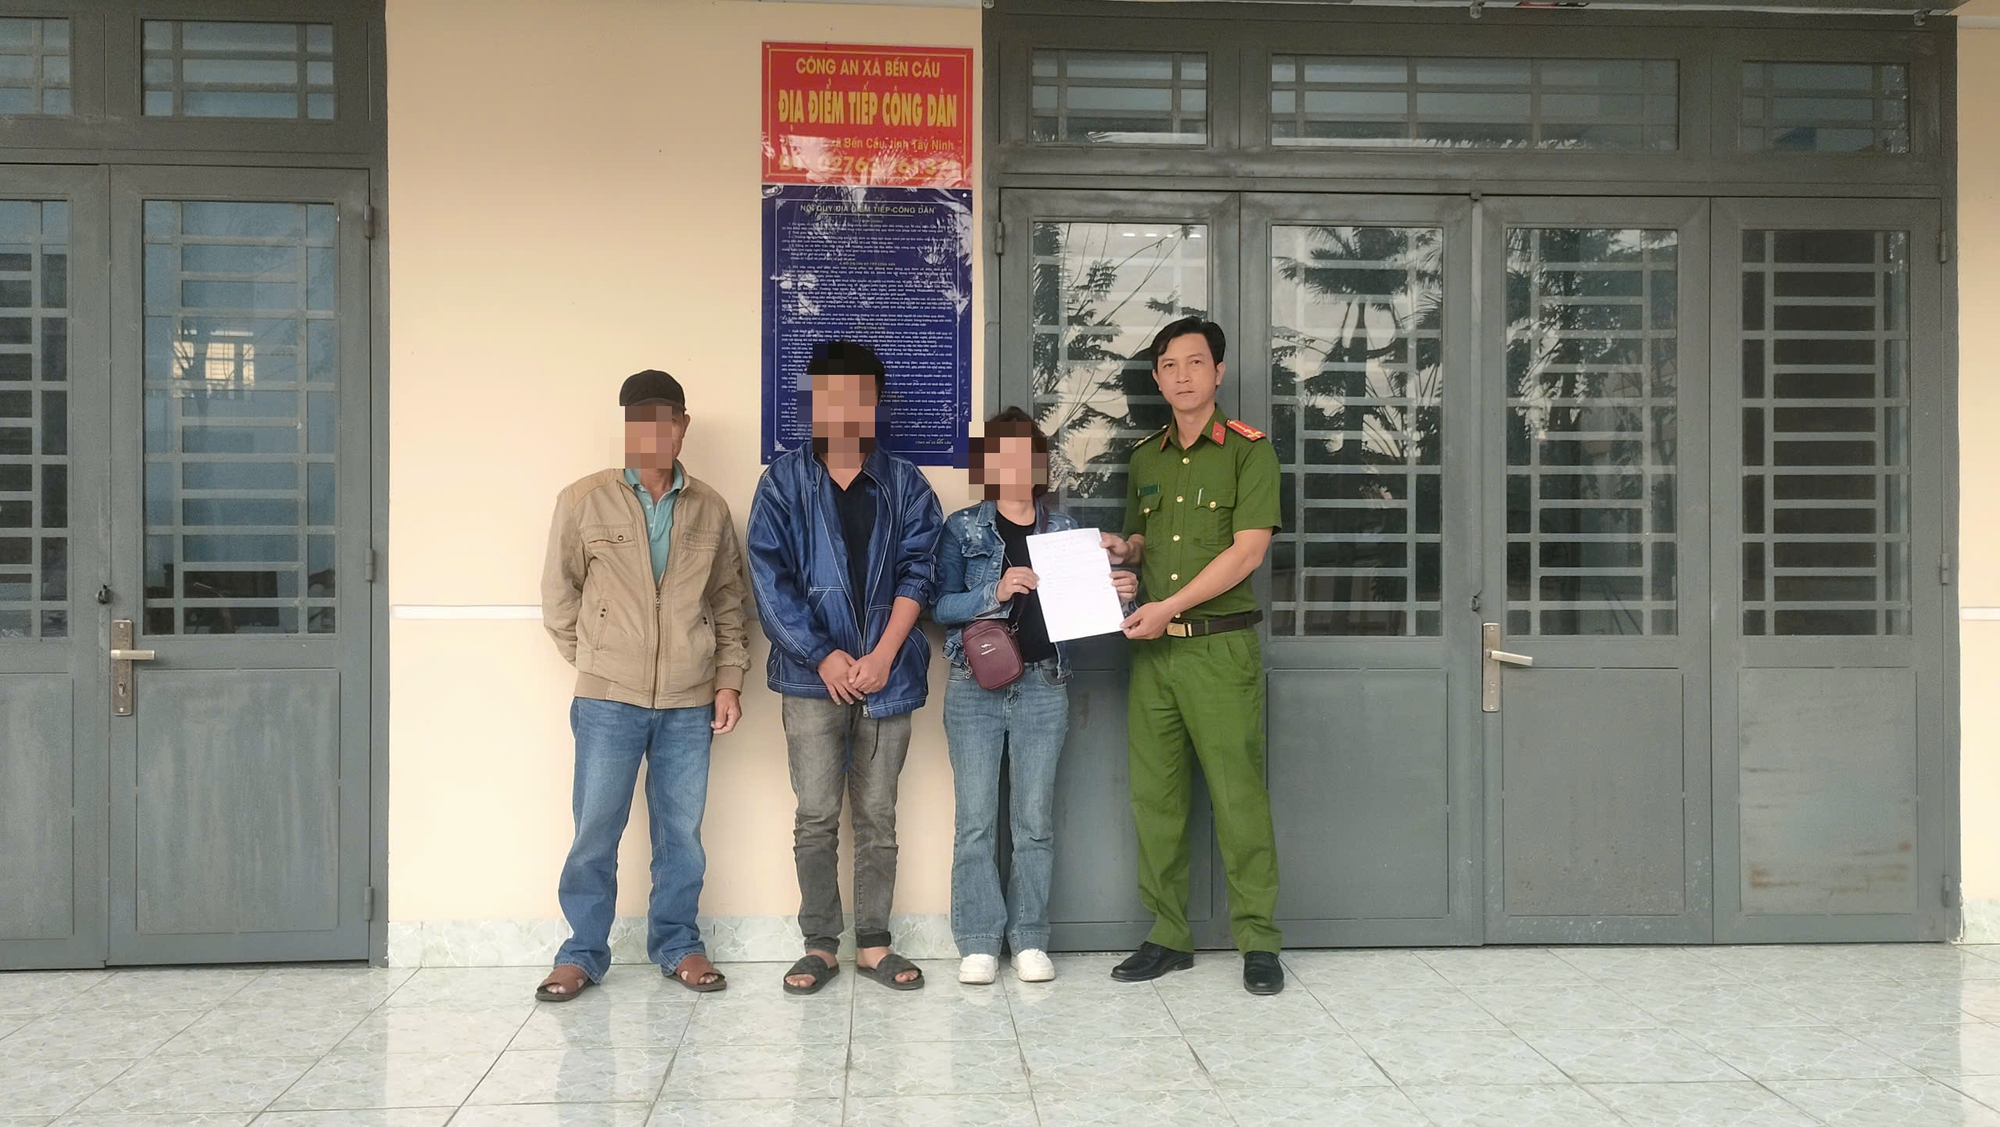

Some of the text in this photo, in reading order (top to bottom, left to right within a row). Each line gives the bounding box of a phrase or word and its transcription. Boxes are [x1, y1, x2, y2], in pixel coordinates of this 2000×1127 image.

[795, 56, 836, 75] CÔNG
[840, 59, 859, 76] AN
[885, 56, 909, 78] BẾN
[778, 78, 957, 131] ĐỊA ĐIỂM TIẾP CÔNG DÂN
[931, 139, 954, 151] Ninh
[892, 205, 916, 215] CÔNG
